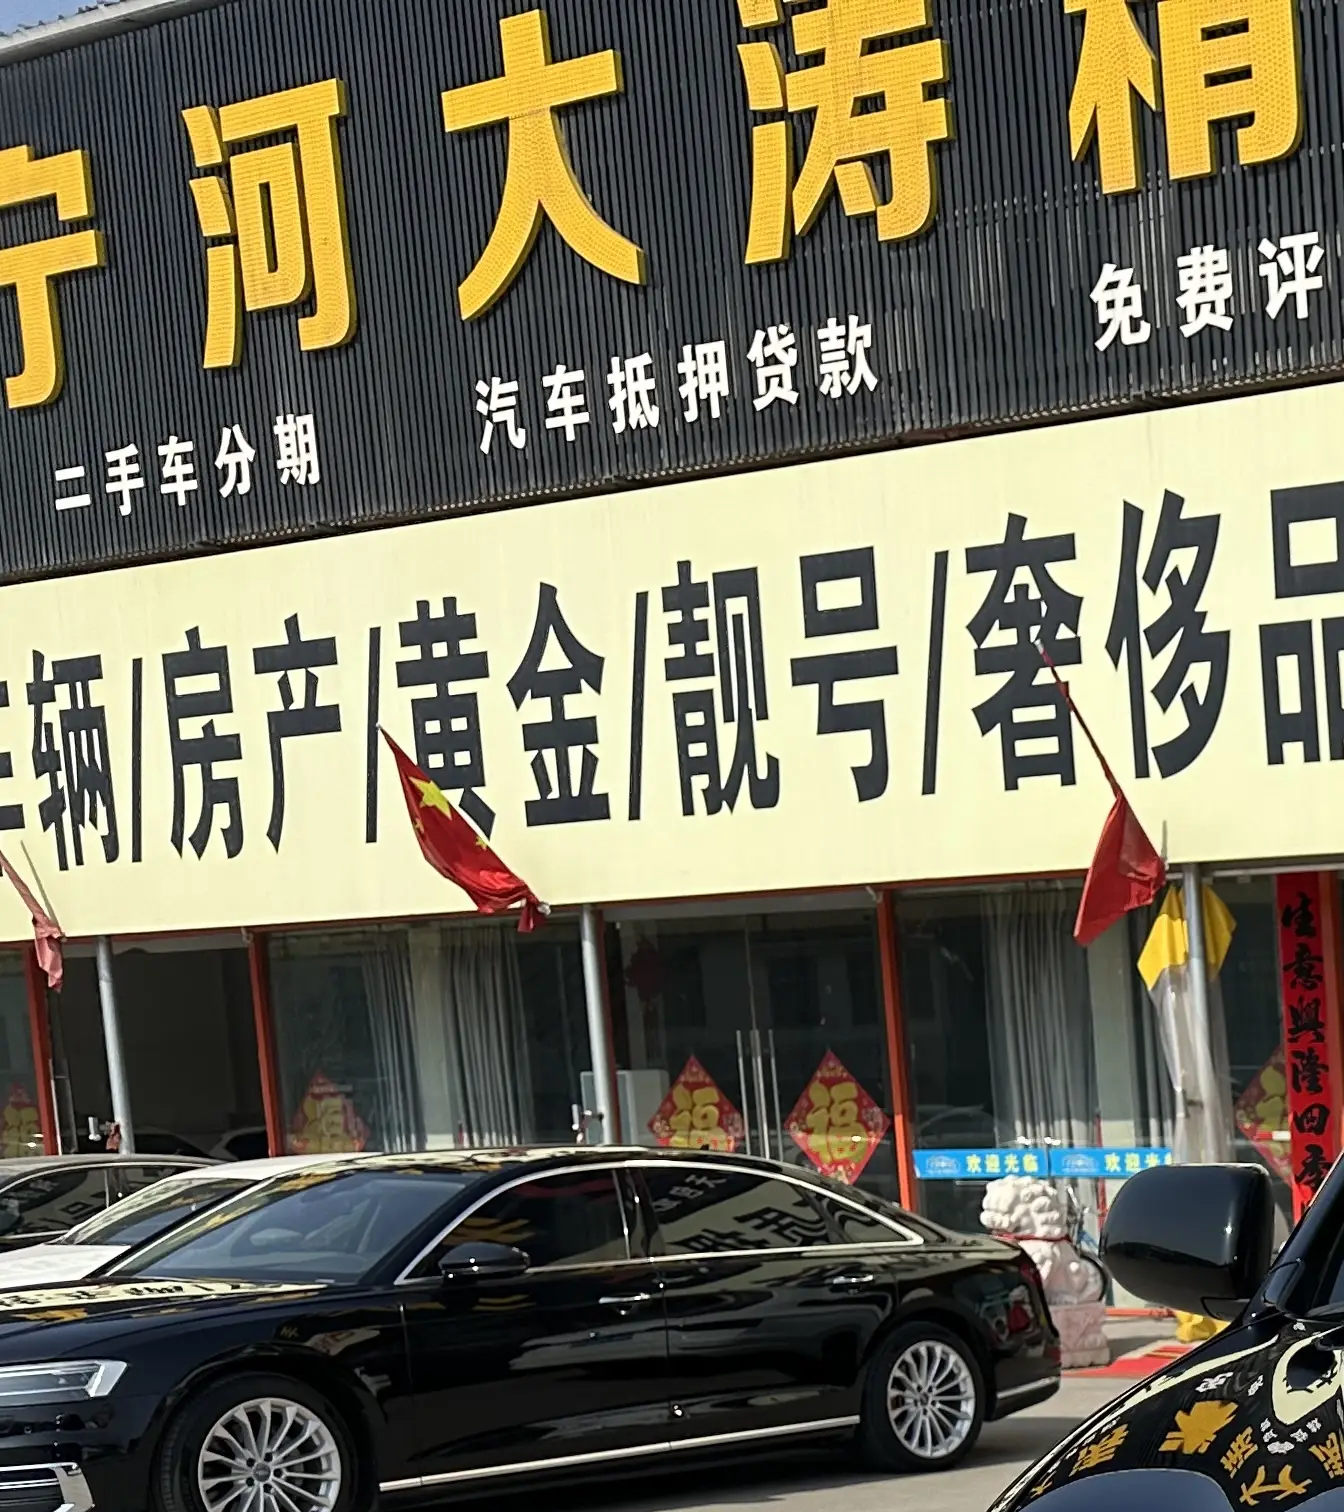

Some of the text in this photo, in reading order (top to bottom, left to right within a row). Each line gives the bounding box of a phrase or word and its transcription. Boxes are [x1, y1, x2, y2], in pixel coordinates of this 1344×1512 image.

[54, 413, 320, 516] 二手车分期
[475, 314, 878, 455] 汽车抵押贷款
[966, 1153, 1039, 1174] 欢迎光临
